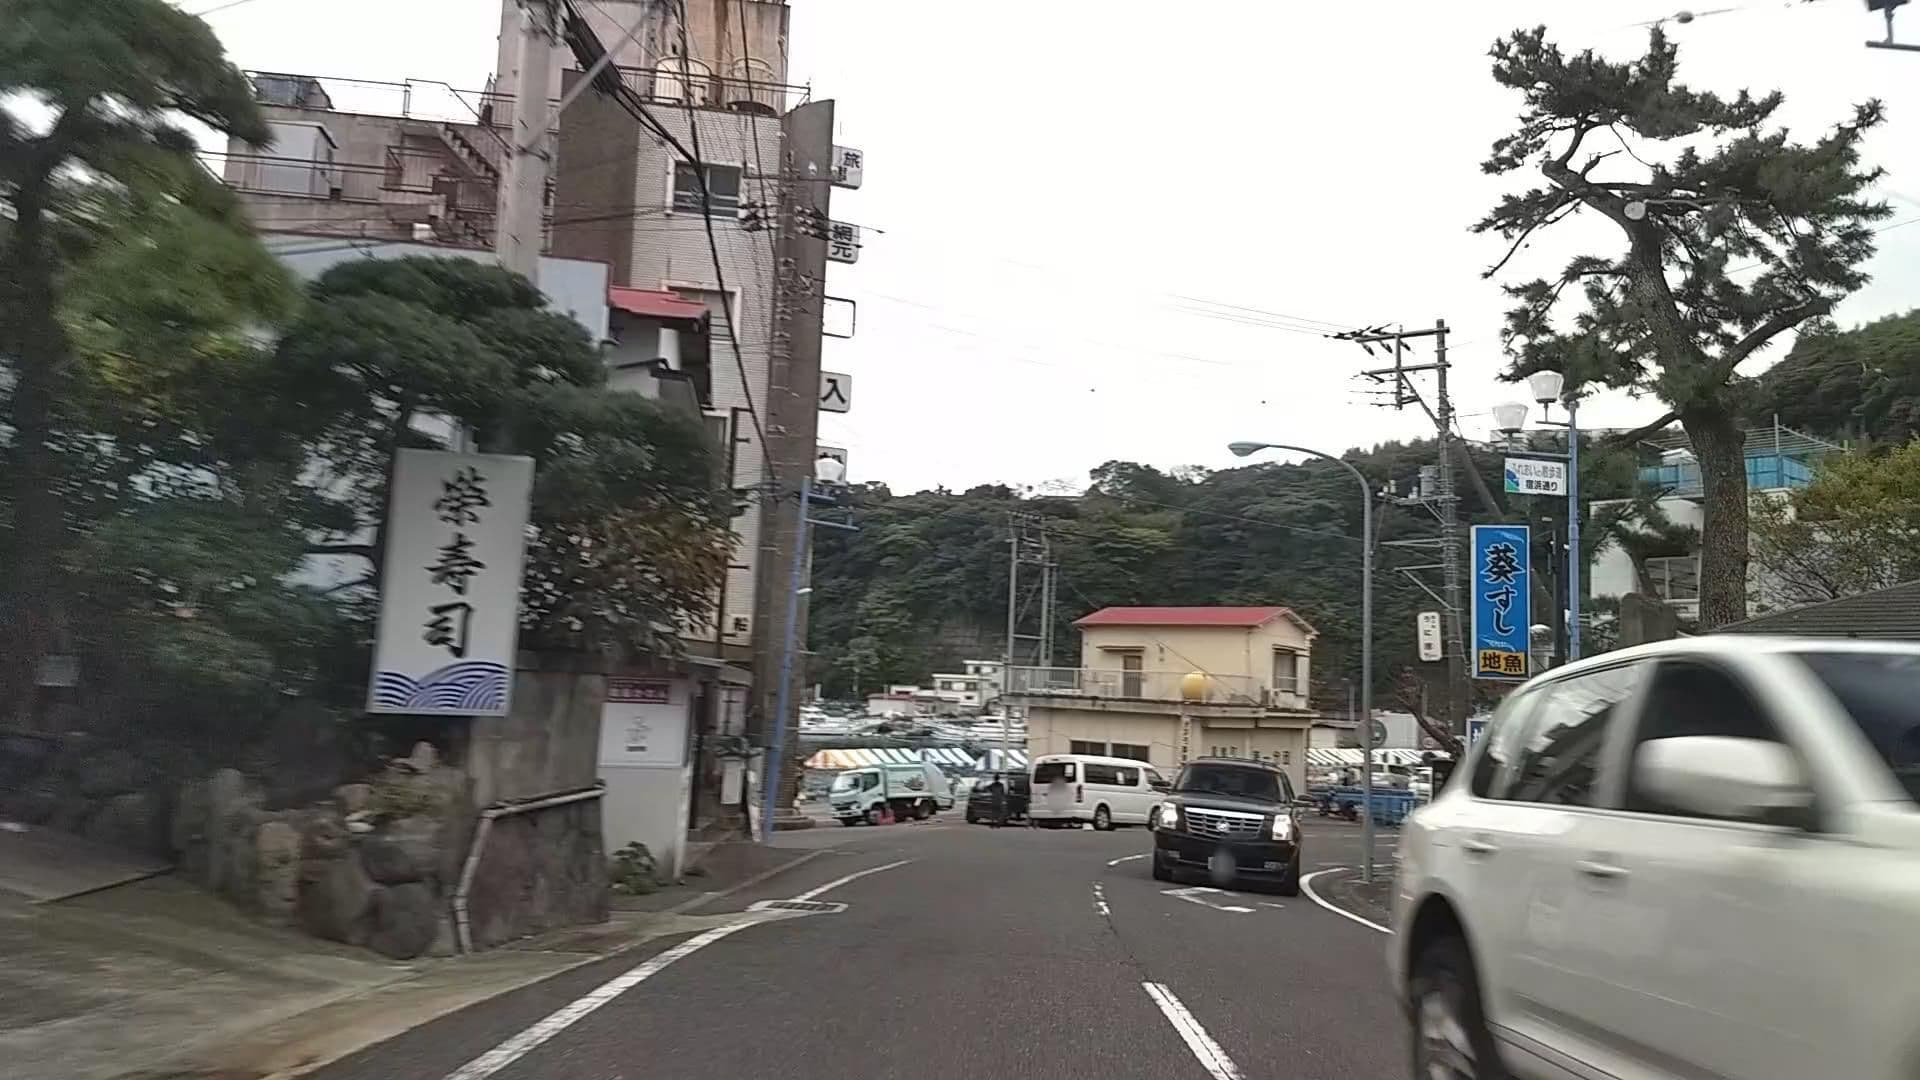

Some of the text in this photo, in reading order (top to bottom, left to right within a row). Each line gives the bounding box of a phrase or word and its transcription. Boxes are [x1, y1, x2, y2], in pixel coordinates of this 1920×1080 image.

[820, 377, 847, 405] 入
[1482, 543, 1525, 635] 葵すし
[1481, 652, 1524, 673] 地魚
